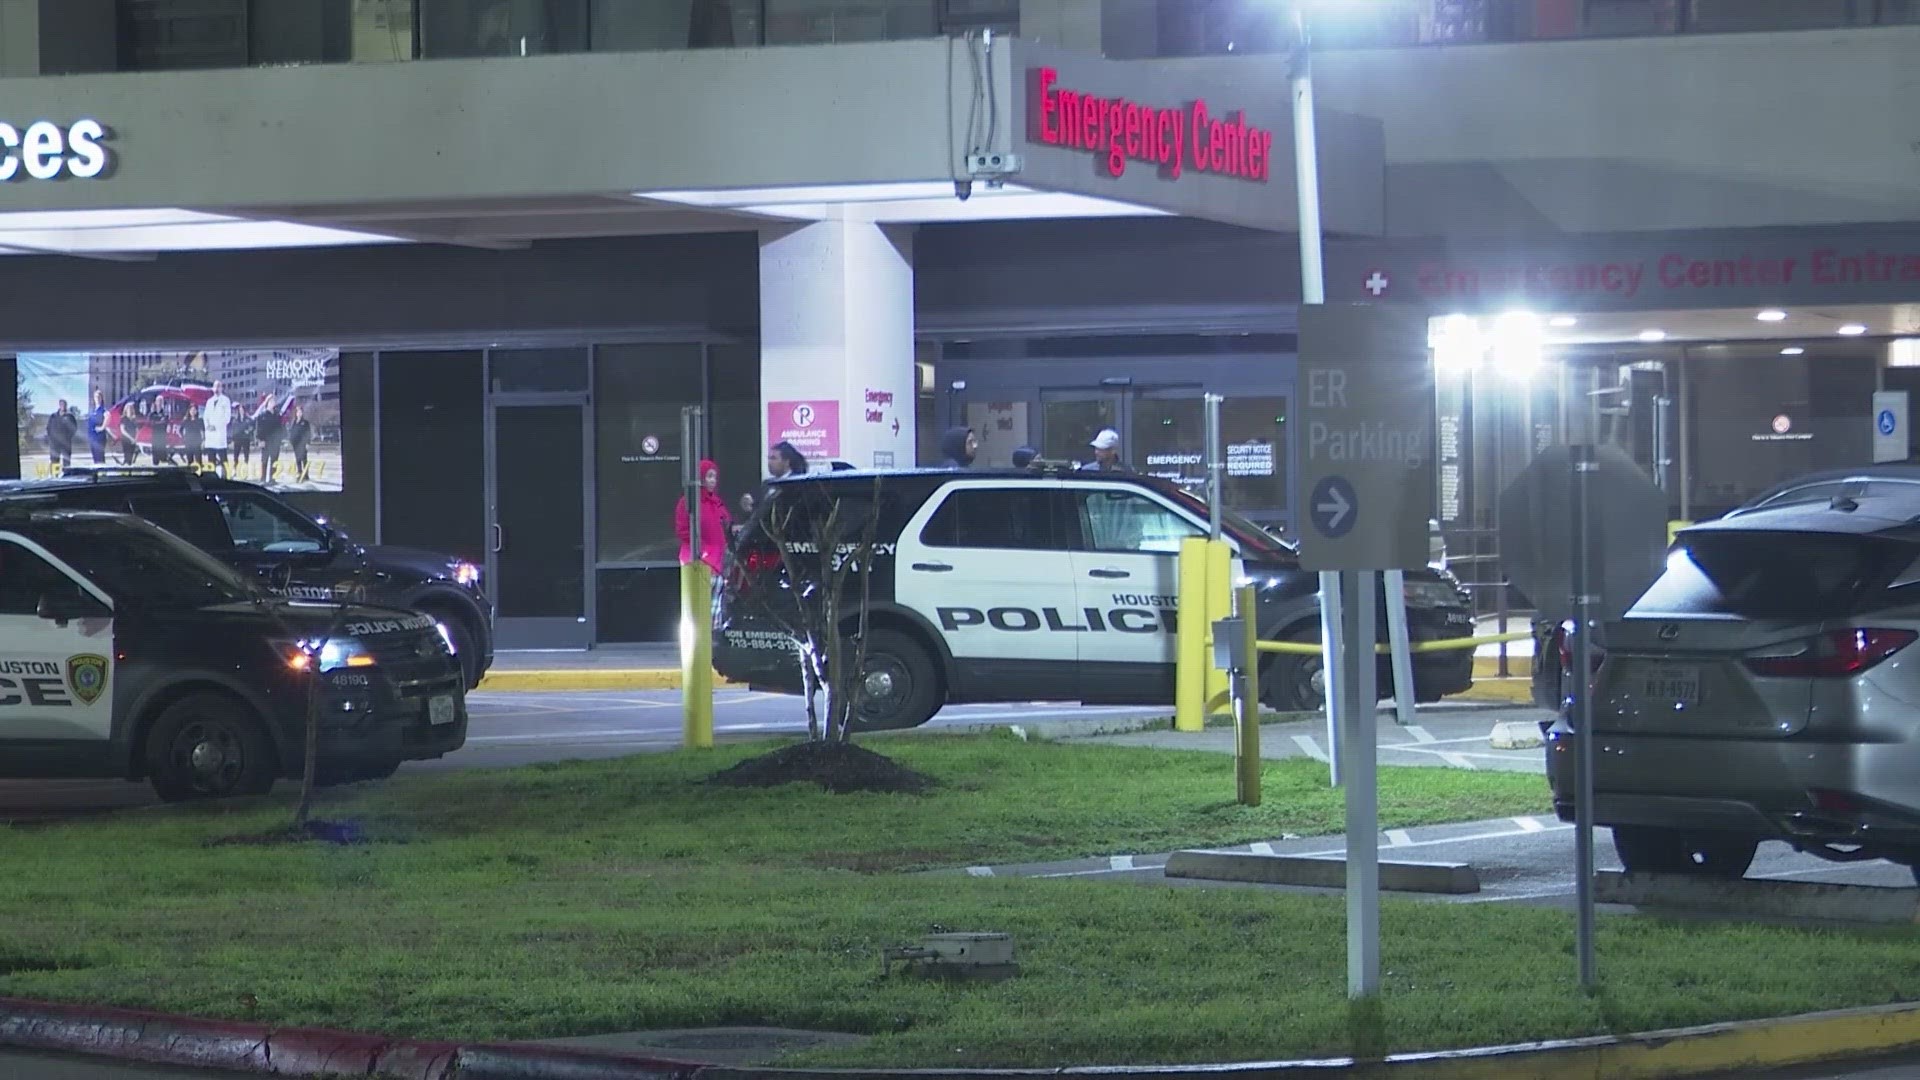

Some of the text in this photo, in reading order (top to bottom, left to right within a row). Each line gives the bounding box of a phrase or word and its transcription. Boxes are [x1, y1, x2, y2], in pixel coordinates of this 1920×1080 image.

[1040, 67, 1272, 183] Emergency Center
[1417, 258, 1646, 298] Emency
[1657, 252, 1796, 289] Center
[266, 367, 326, 379] HERMANN
[1308, 368, 1348, 408] ER
[865, 388, 893, 408] Emergency
[865, 408, 884, 424] Center
[781, 430, 827, 438] AMBULANCE
[1308, 420, 1422, 470] Parking
[1147, 455, 1202, 465] EMERGENCY
[1227, 462, 1272, 470] REQUIRED
[332, 674, 367, 686] 48190
